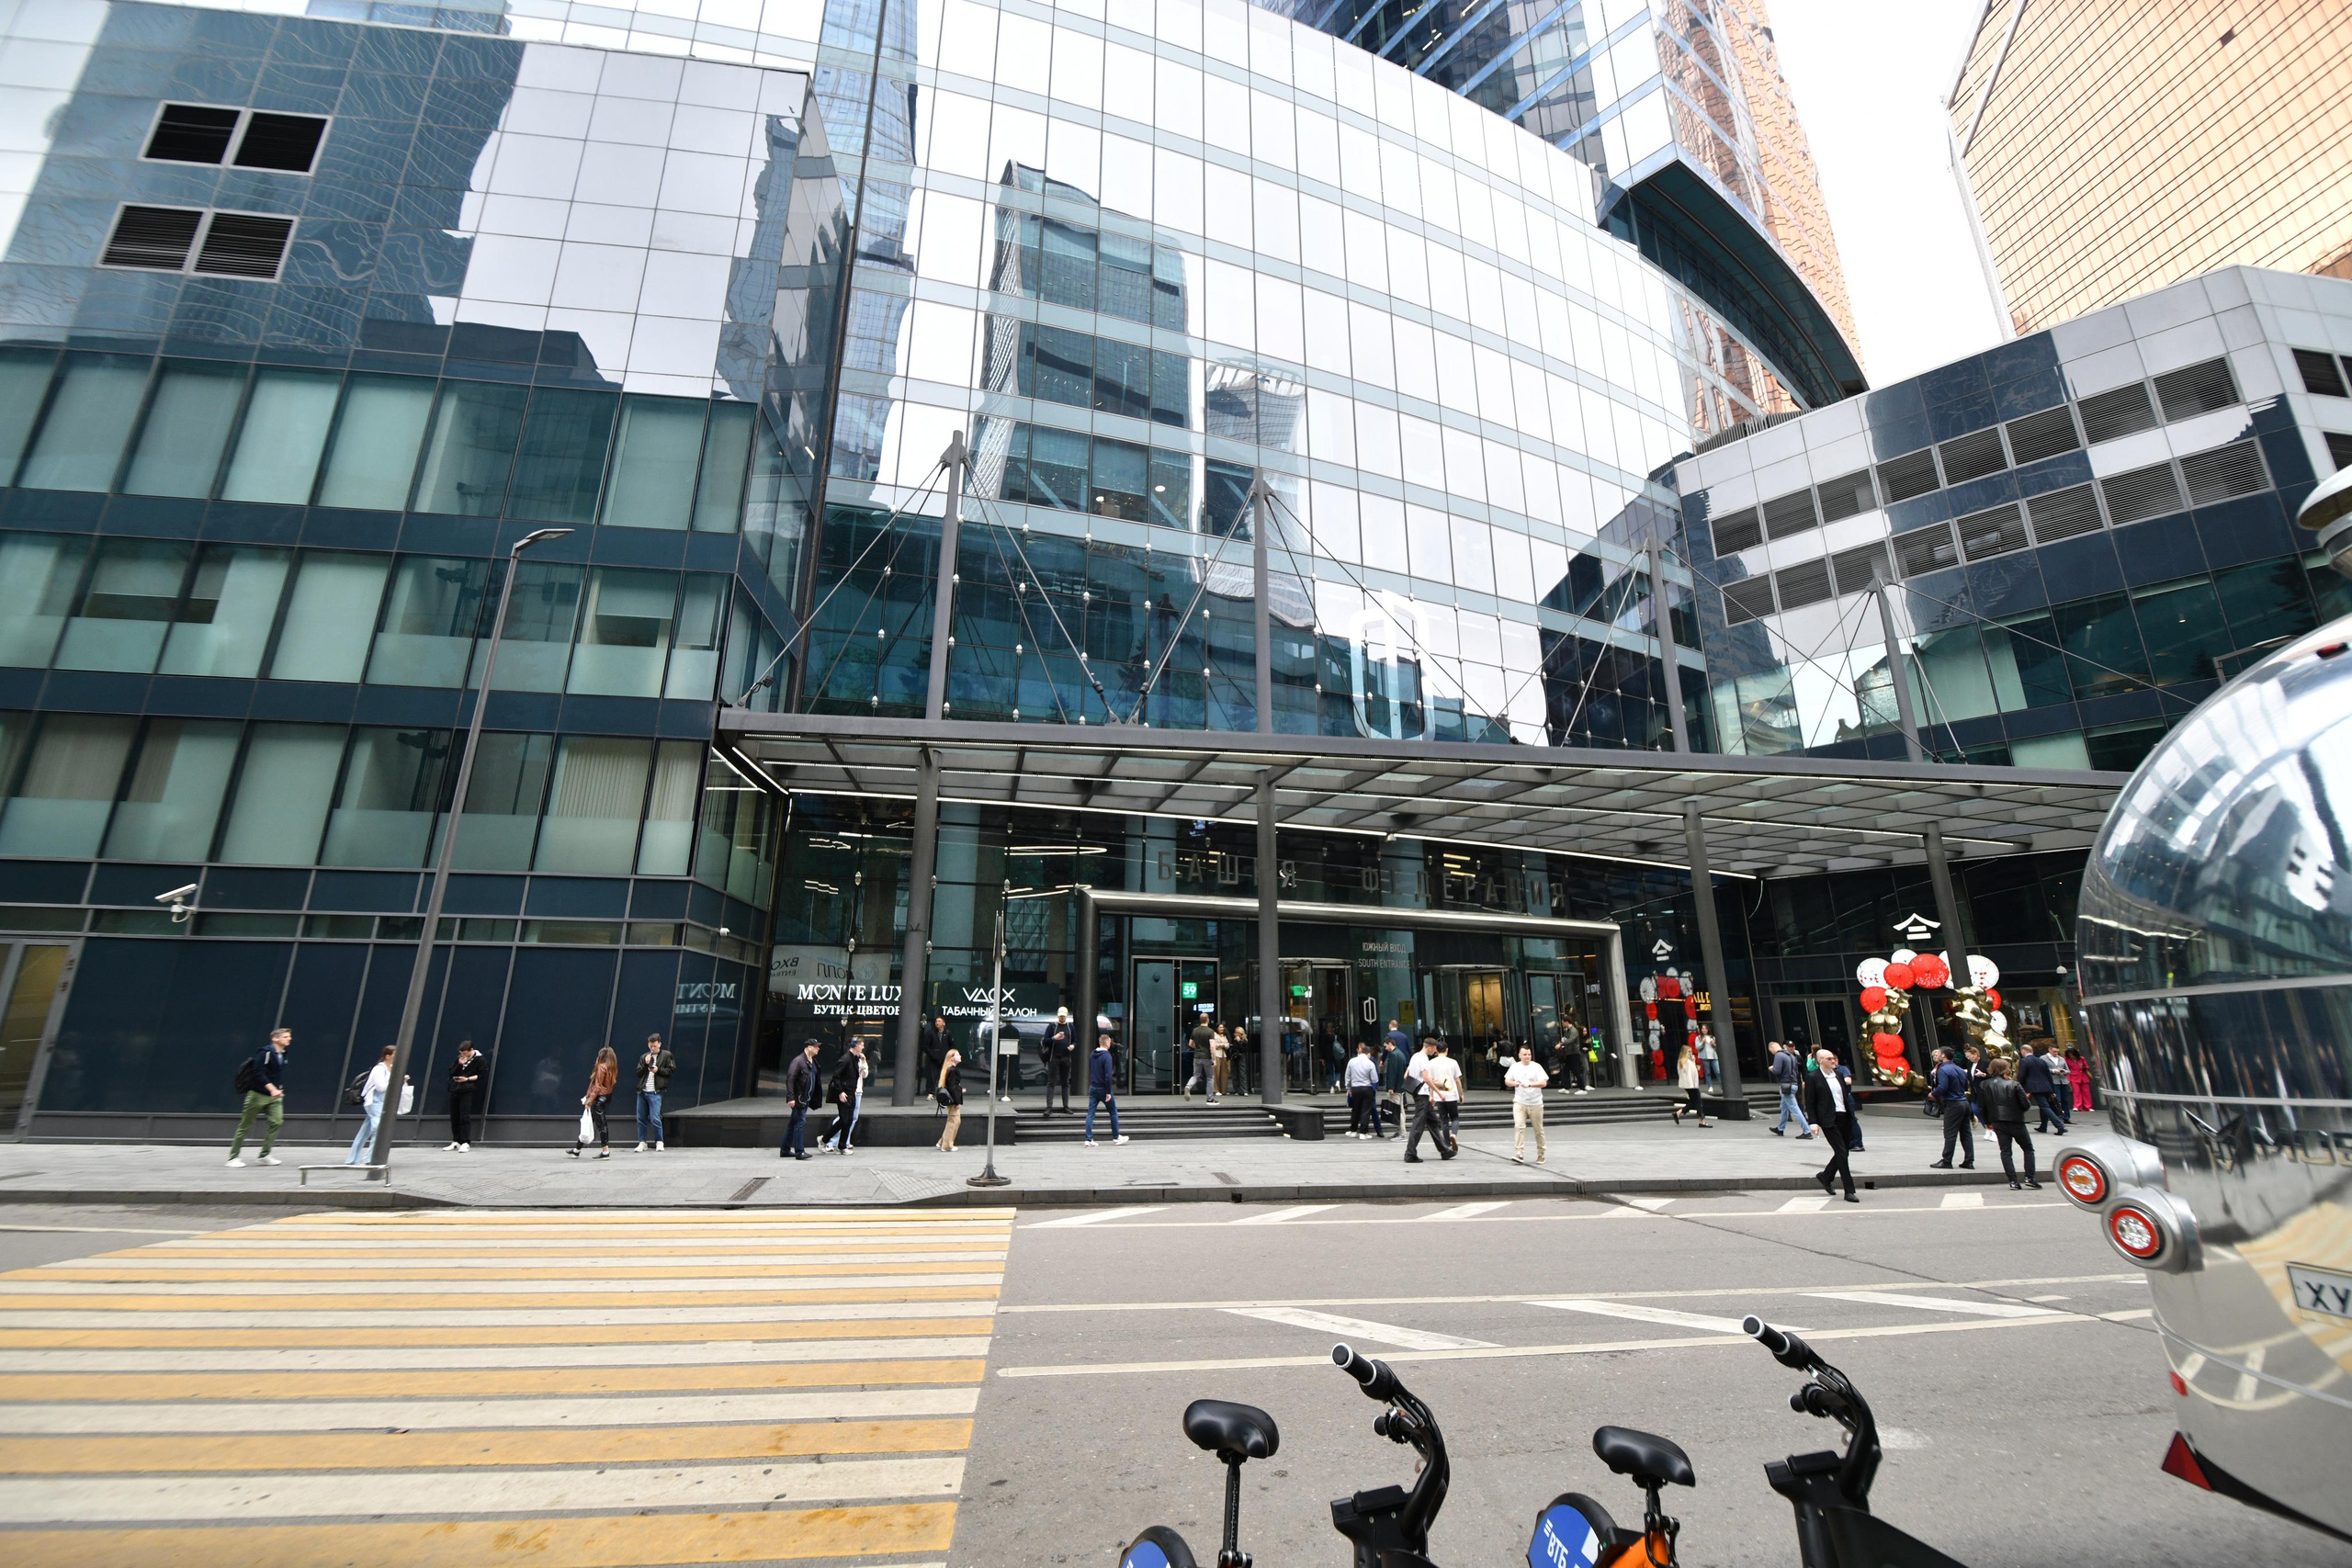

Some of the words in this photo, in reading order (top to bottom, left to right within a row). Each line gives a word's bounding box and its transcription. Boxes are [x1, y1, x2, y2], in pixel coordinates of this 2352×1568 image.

[1158, 851, 1296, 888] БАШЯ
[1361, 867, 1566, 909] ФЕДЕРАЦИЯ
[1362, 942, 1388, 953] ЮЖНЫЙ
[1389, 944, 1406, 953] ВХОД
[1358, 959, 1379, 968] SOUTH
[1379, 960, 1411, 969] ENTRANCE
[1182, 985, 1197, 996] 59
[813, 1004, 854, 1016] БУТИК
[1000, 1007, 1037, 1018] САЛОН
[1546, 1530, 1569, 1568] ВТБ
